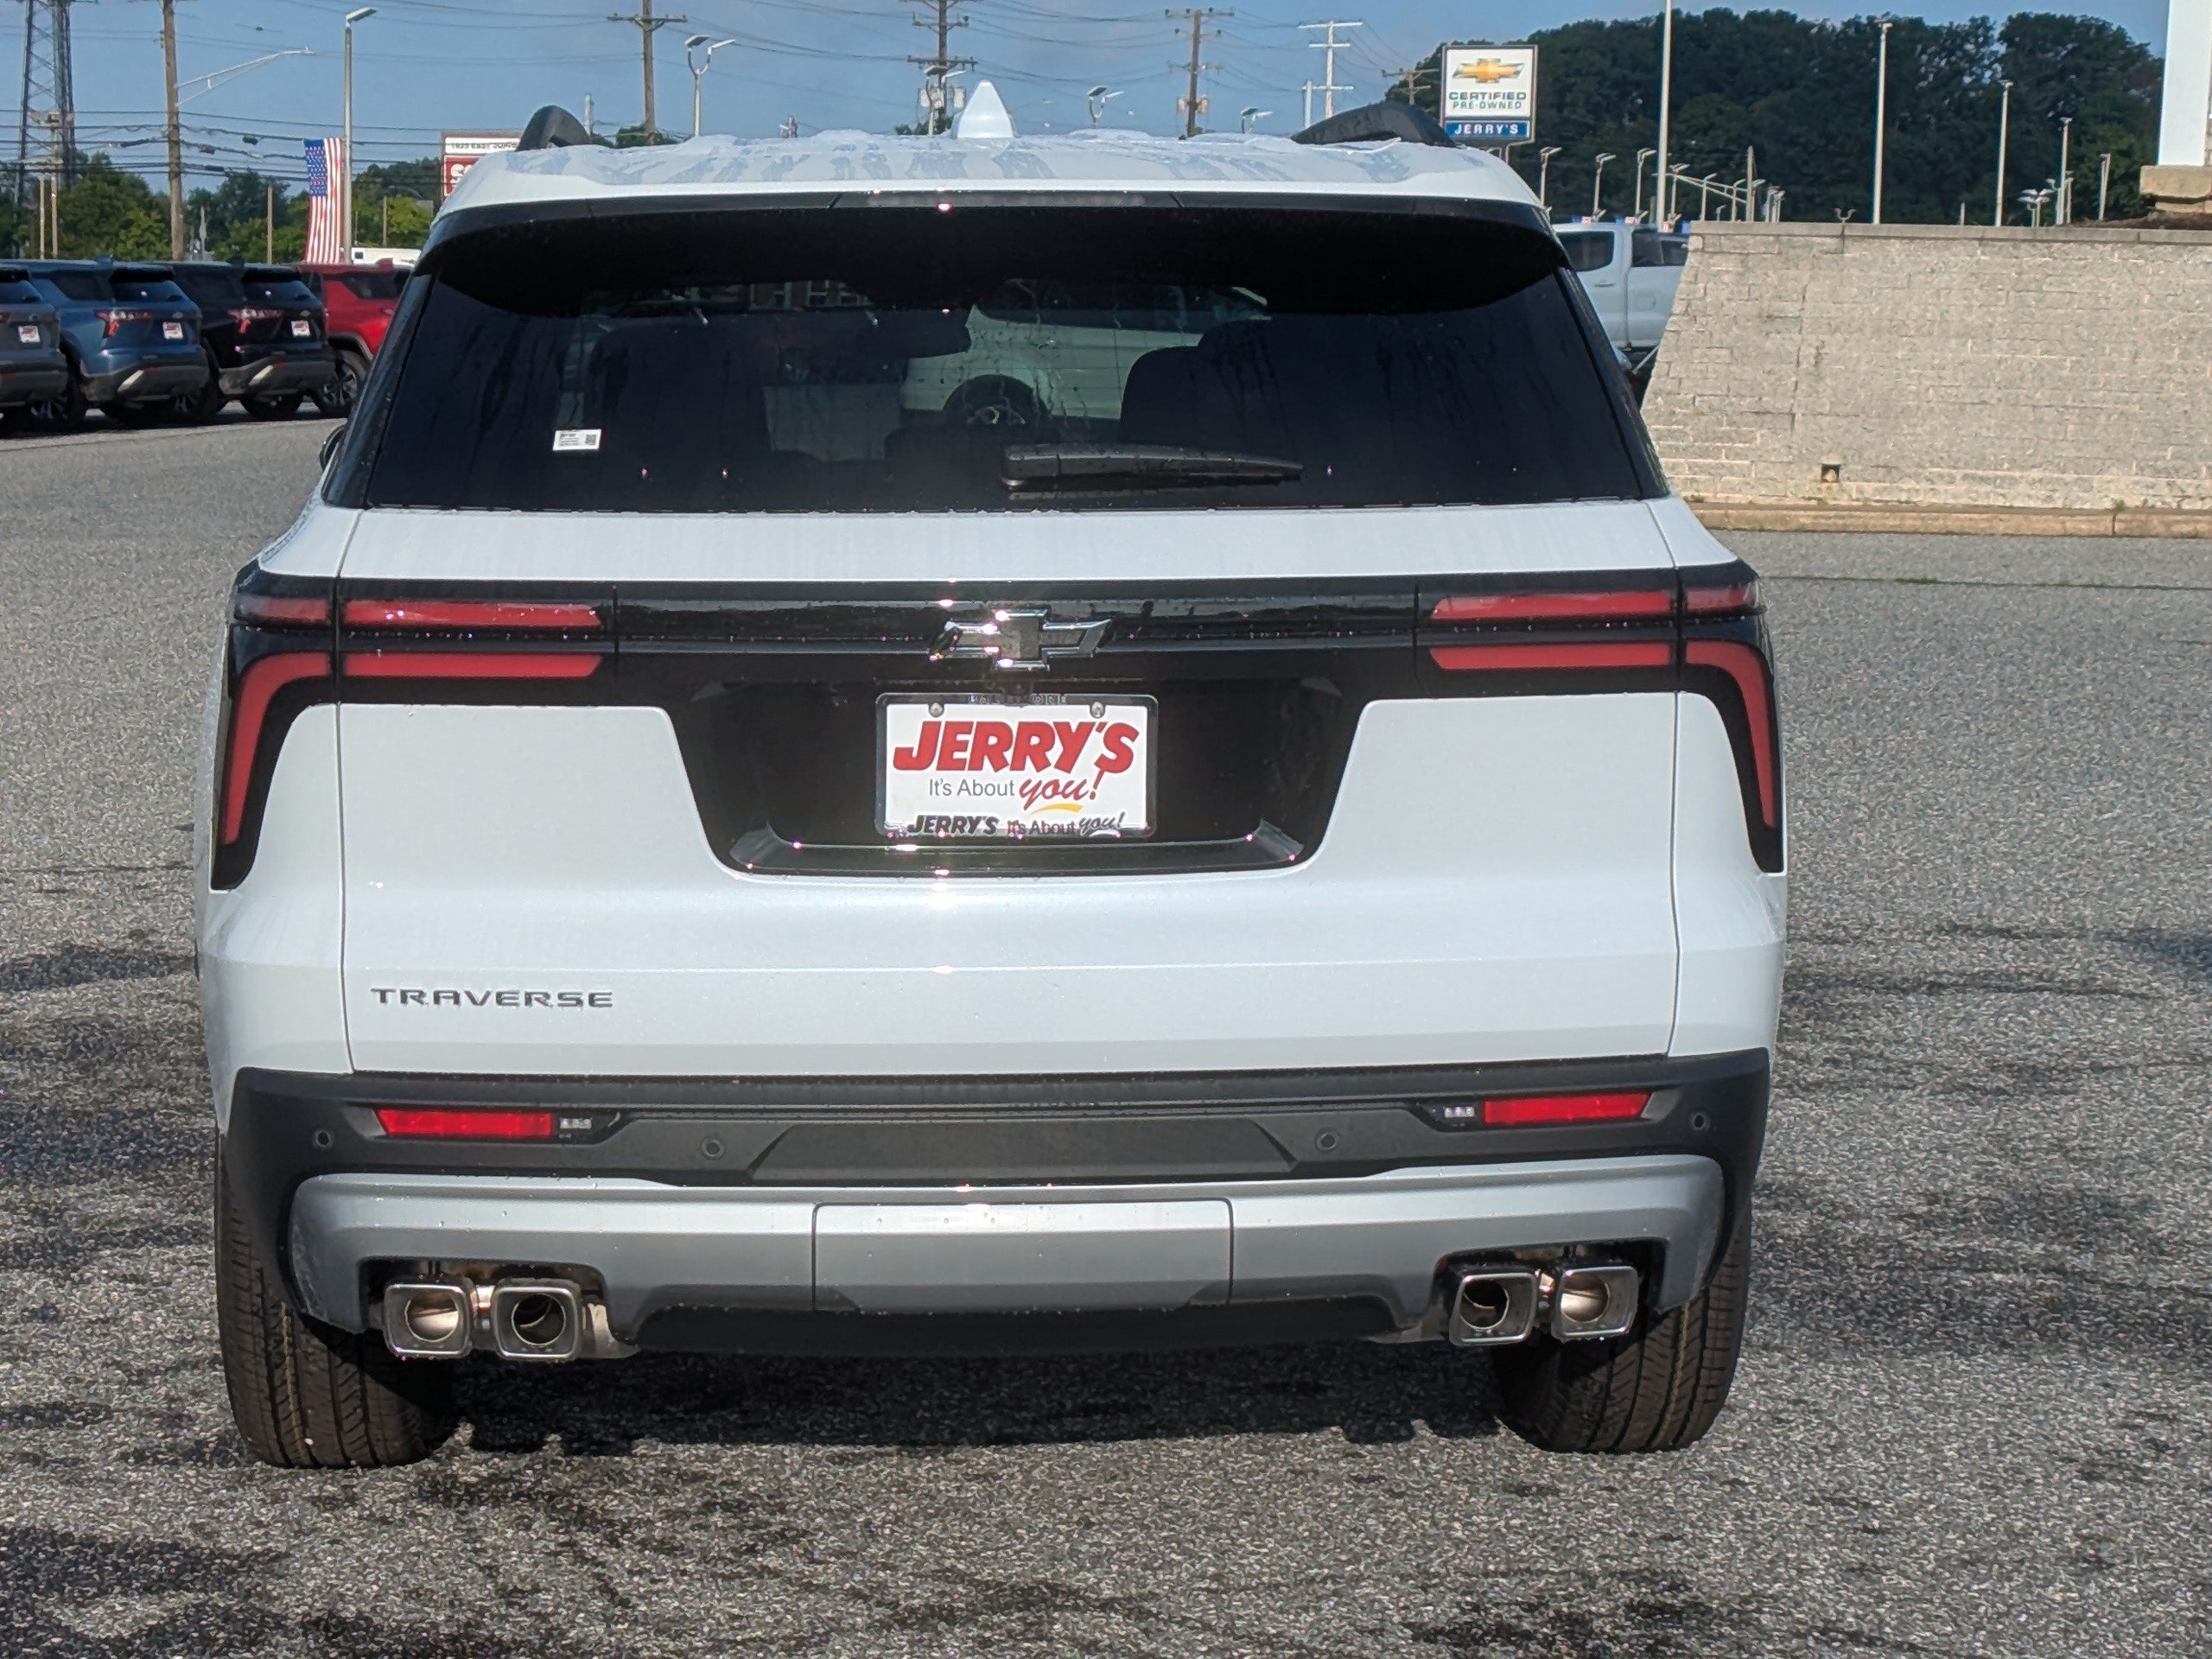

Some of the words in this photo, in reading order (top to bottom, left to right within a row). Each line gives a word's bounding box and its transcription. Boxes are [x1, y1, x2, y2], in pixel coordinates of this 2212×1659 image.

[1448, 92, 1527, 100] CERTIFIED
[1454, 124, 1519, 135] JERRY'S
[893, 721, 1140, 774] JERRY'S
[928, 779, 952, 797] It's
[957, 779, 1015, 797] About
[1019, 768, 1105, 811] you!
[906, 815, 1001, 835] JERRY'S
[1028, 819, 1077, 835] About
[1079, 811, 1125, 835] you!
[370, 987, 613, 1008] TRAVERSE
